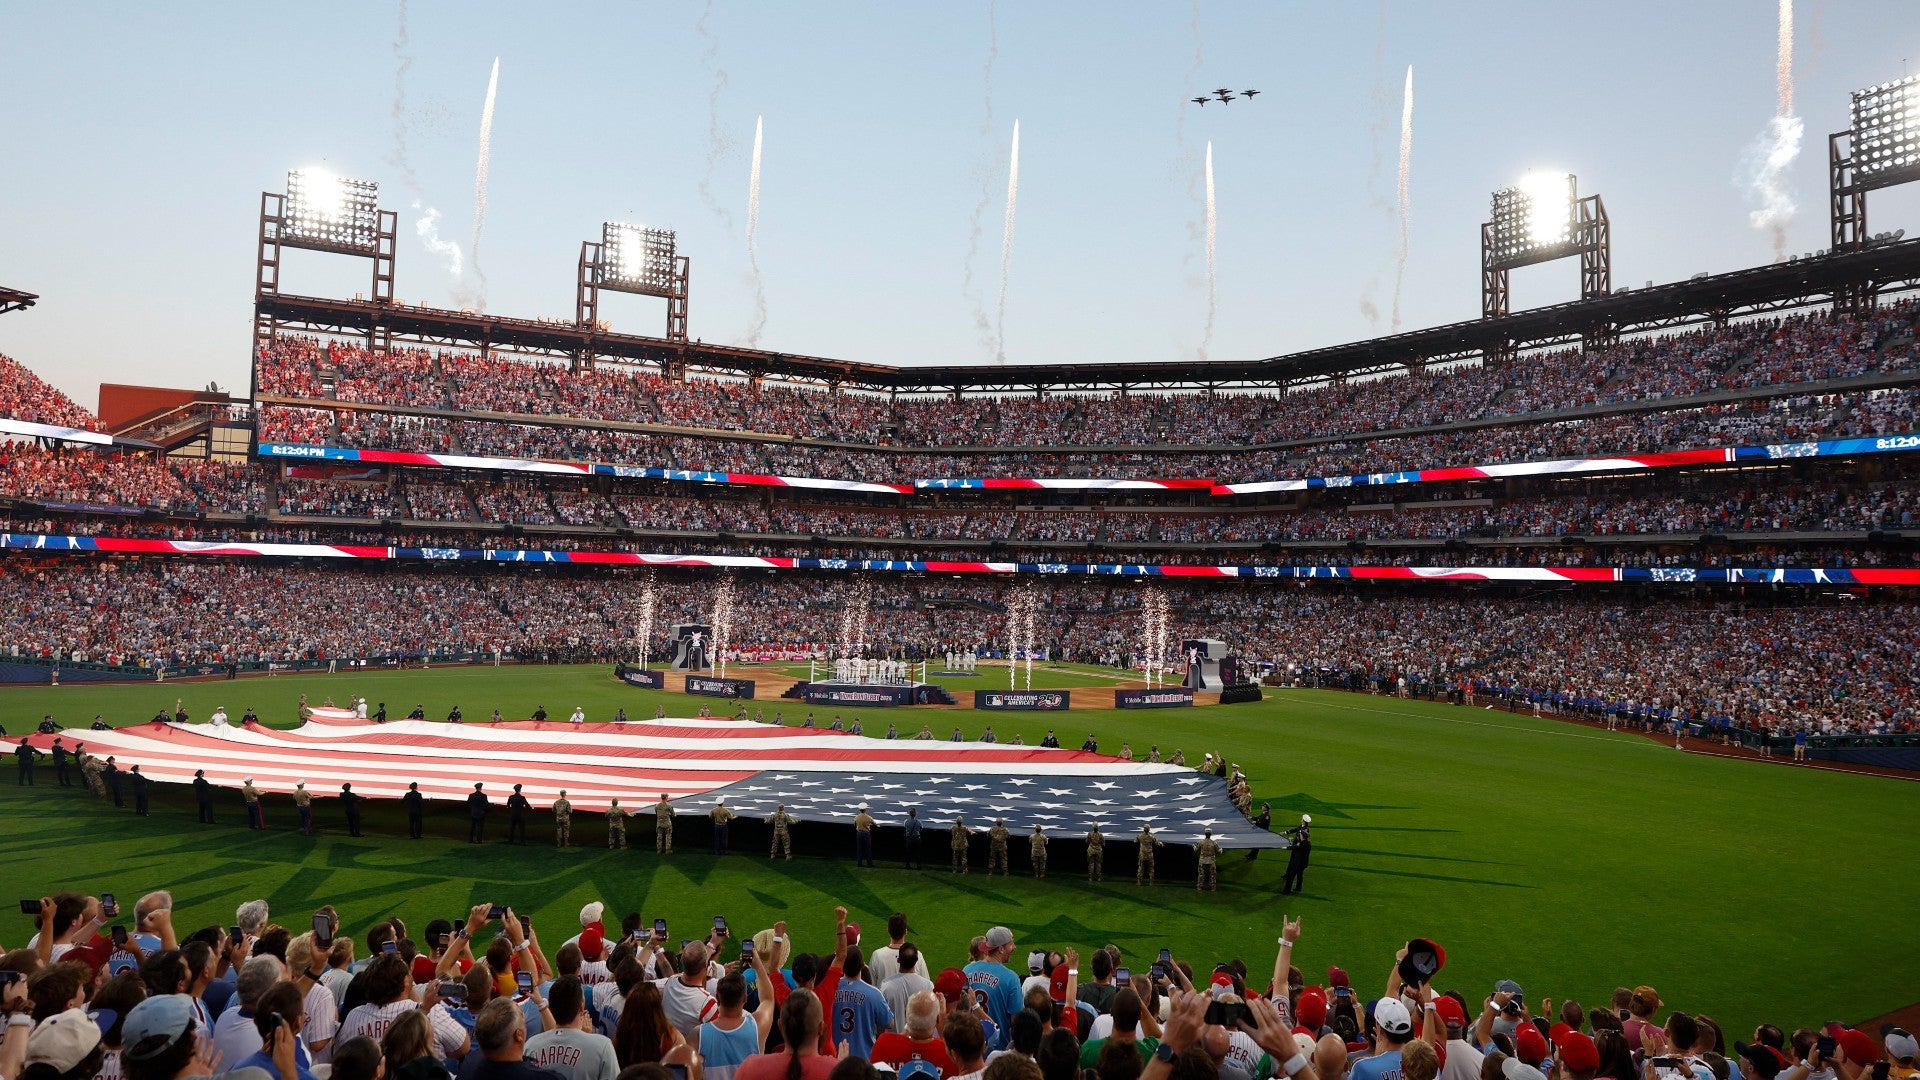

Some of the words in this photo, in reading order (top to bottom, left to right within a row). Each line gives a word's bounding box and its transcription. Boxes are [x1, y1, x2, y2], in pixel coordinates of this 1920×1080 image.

[272, 445, 308, 456] 8:12:04
[309, 448, 325, 456] PM
[839, 1007, 855, 1033] 3
